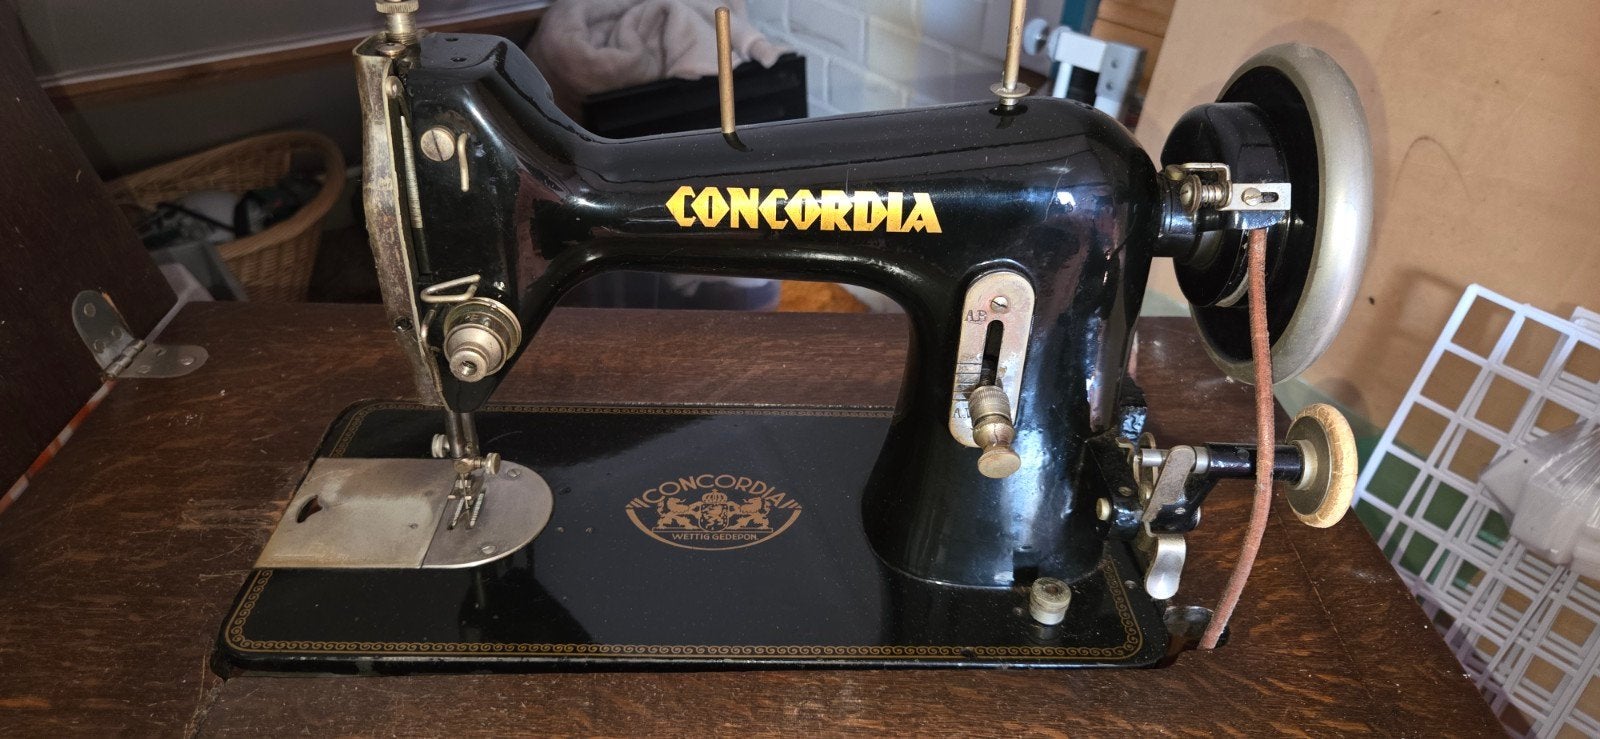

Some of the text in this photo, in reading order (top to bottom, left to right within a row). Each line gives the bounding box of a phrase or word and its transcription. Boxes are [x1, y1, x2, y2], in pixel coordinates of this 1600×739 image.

[665, 185, 943, 233] CONCORDIA
[642, 474, 787, 506] CONCORDIA
[672, 533, 710, 541] WETTIG
